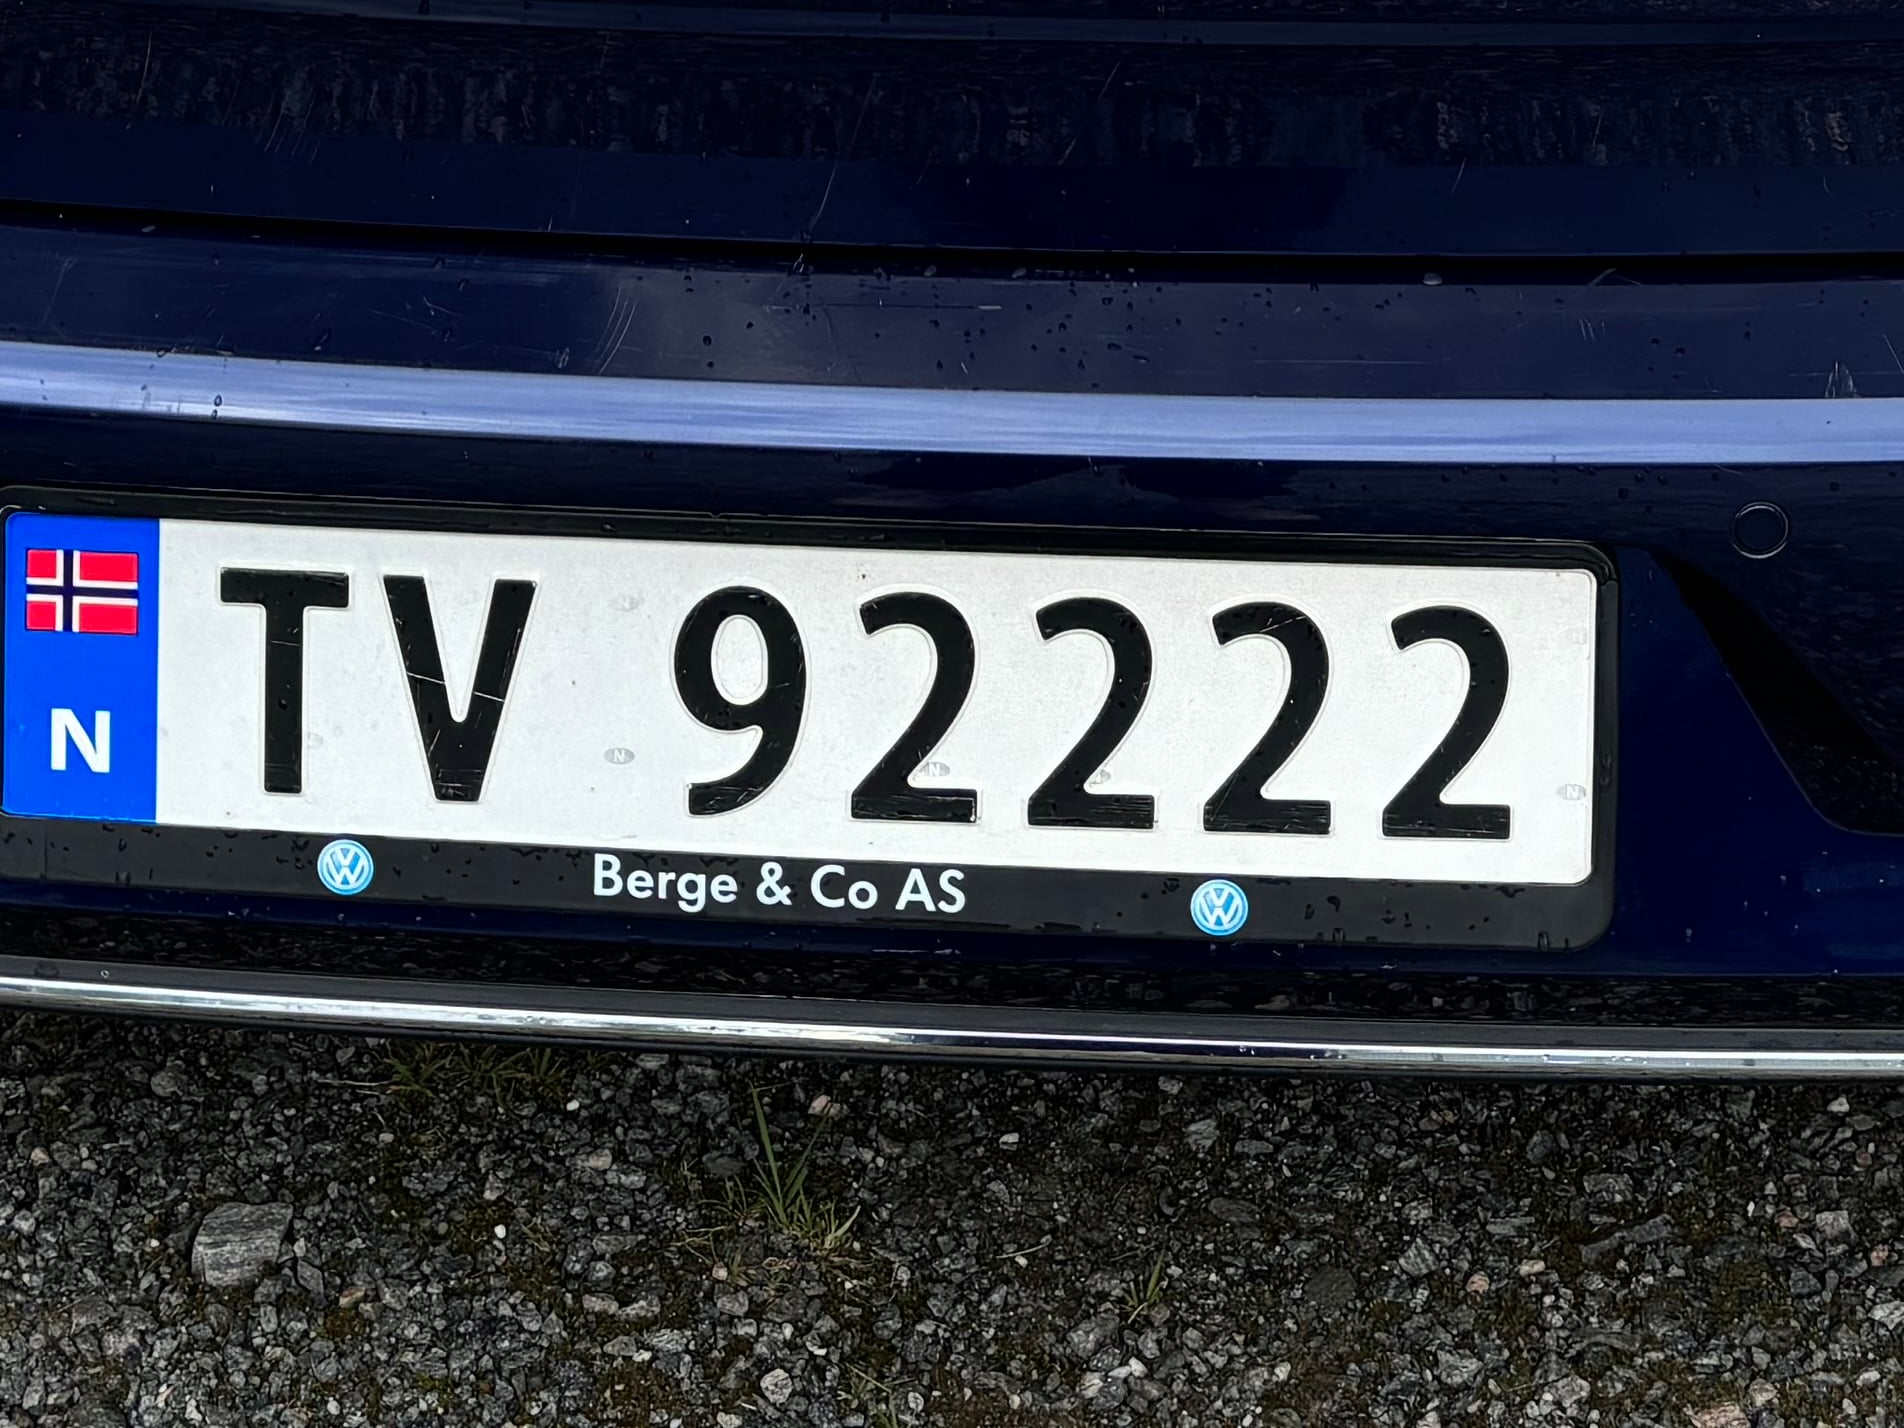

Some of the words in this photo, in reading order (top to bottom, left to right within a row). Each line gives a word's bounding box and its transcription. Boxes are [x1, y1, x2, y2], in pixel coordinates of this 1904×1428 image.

[51, 707, 111, 774] N
[218, 566, 539, 804] TV
[672, 583, 1513, 842] 92222
[592, 852, 739, 914] Berge
[755, 861, 794, 907] &
[810, 863, 880, 911] Co
[894, 867, 967, 915] AS
